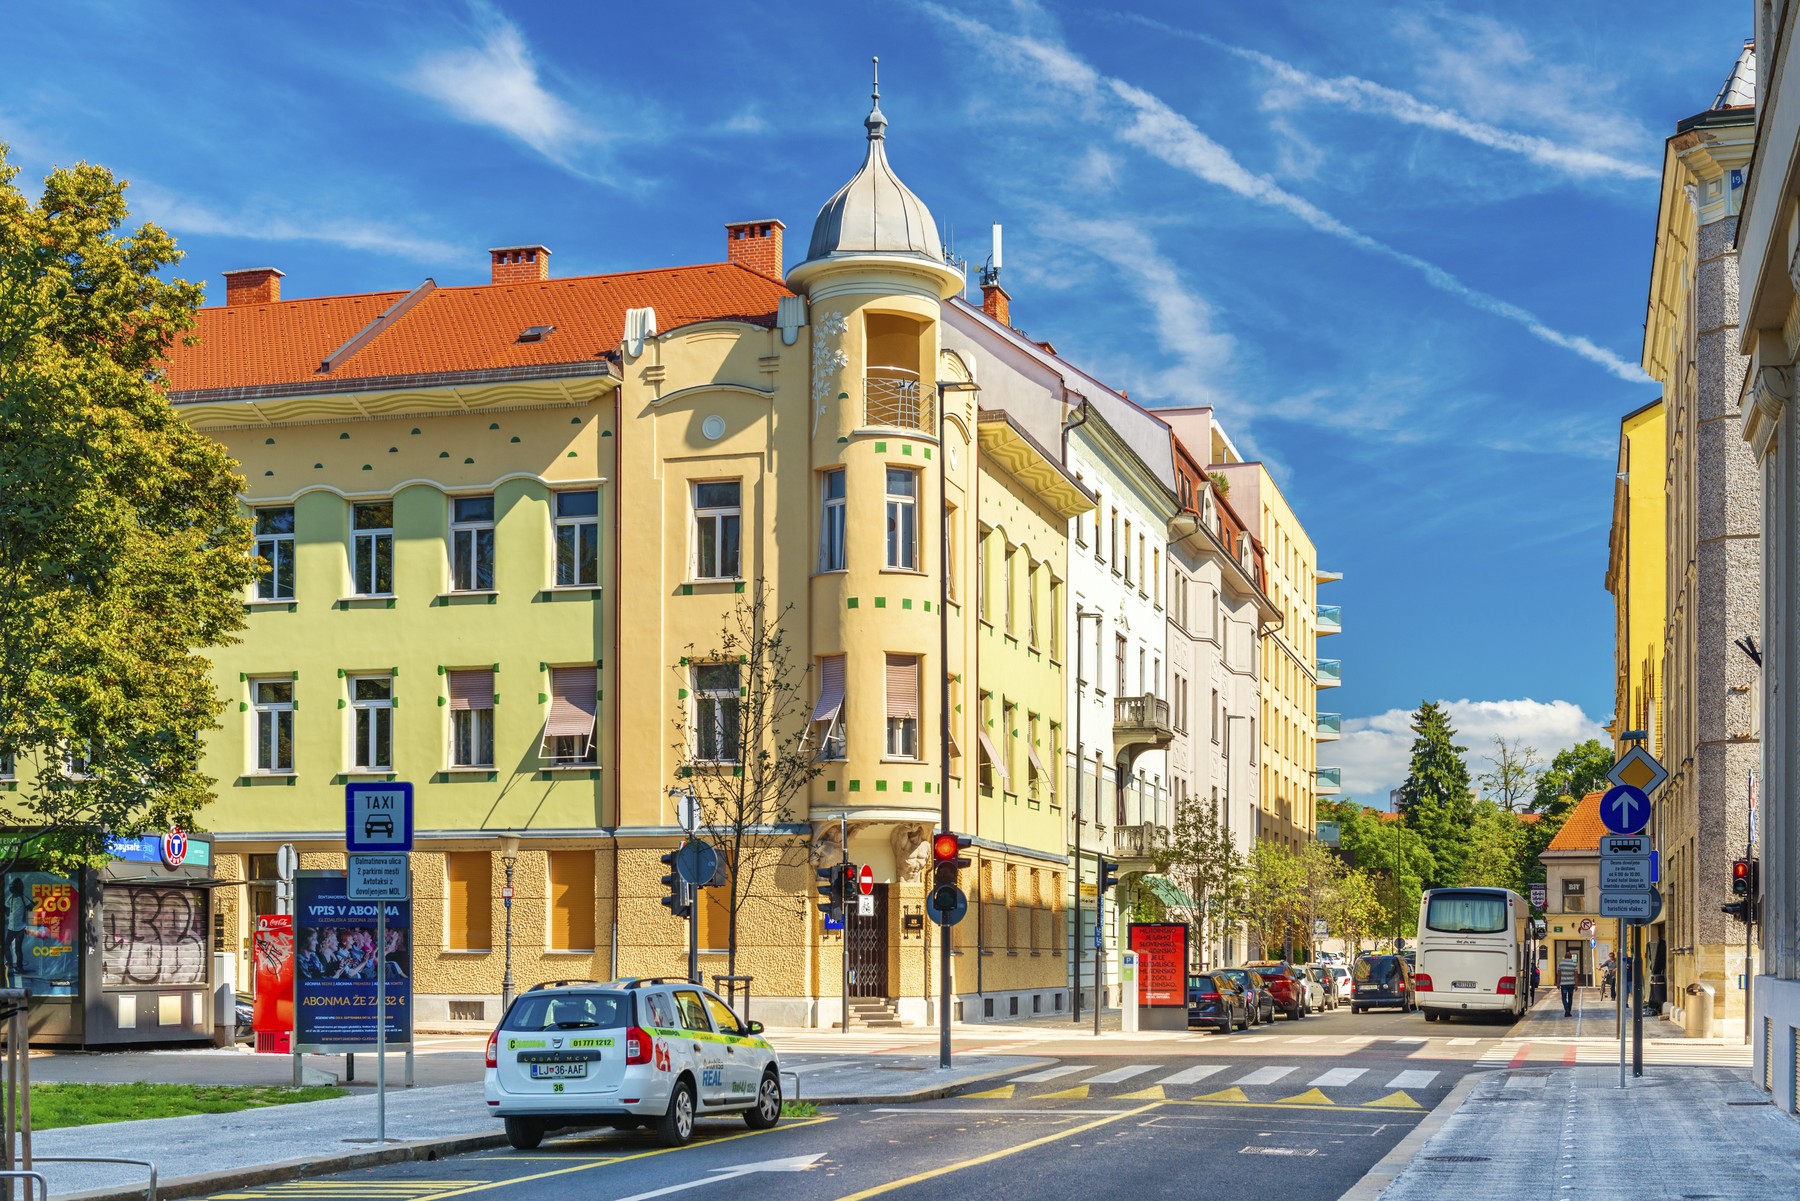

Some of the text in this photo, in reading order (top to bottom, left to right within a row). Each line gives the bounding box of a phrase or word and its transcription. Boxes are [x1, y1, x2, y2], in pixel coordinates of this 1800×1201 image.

[365, 796, 394, 809] TAXI
[172, 839, 181, 855] T
[355, 857, 402, 865] Dalmatinova ulica
[357, 867, 400, 877] 2 parkirni mesti
[363, 877, 388, 885] Avtotaksi
[31, 883, 71, 897] FREE
[355, 887, 400, 896] dovoljenjem MOL
[32, 896, 71, 912] 2GO
[308, 906, 335, 916] VPIS
[337, 906, 346, 916] V
[303, 996, 351, 1006] ABONMA
[353, 994, 367, 1006] ŽE
[385, 996, 397, 1005] 32
[398, 996, 405, 1005] €
[582, 1039, 594, 1047] 777
[702, 1070, 722, 1086] REAL
[554, 1083, 564, 1092] 36
